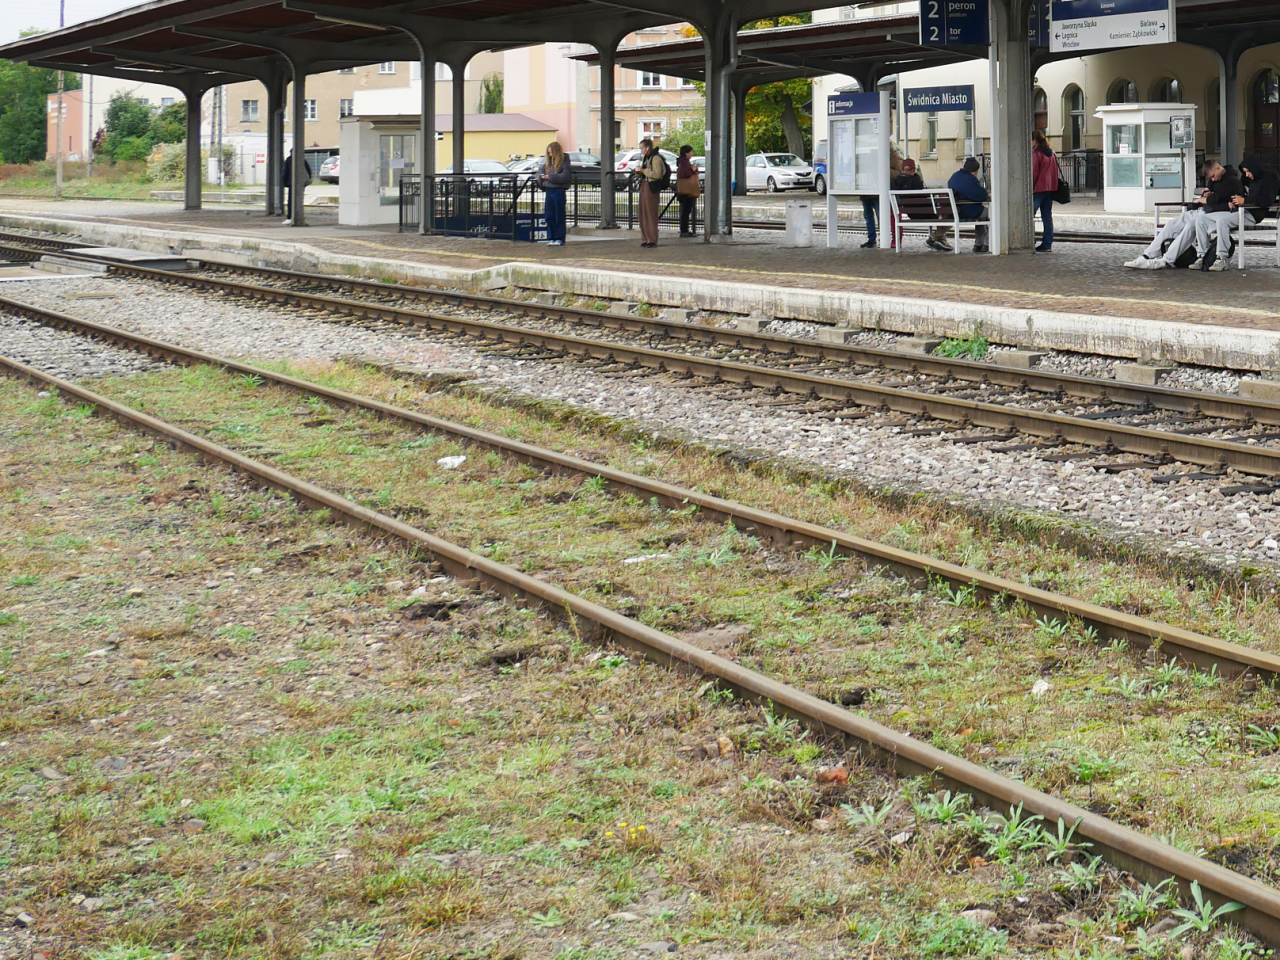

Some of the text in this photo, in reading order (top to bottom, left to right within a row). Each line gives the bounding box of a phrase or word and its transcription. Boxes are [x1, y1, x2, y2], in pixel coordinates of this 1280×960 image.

[928, 1, 976, 18] 2 peron
[1061, 20, 1097, 30] Jaworzyna Śląska
[1140, 19, 1158, 28] Bielawa
[929, 26, 939, 41] 2
[949, 27, 961, 35] tor
[1061, 31, 1078, 40] Legnica
[1109, 29, 1158, 40] Kamieniec Ząbkowicki
[907, 92, 968, 107] Świdnica Miasto
